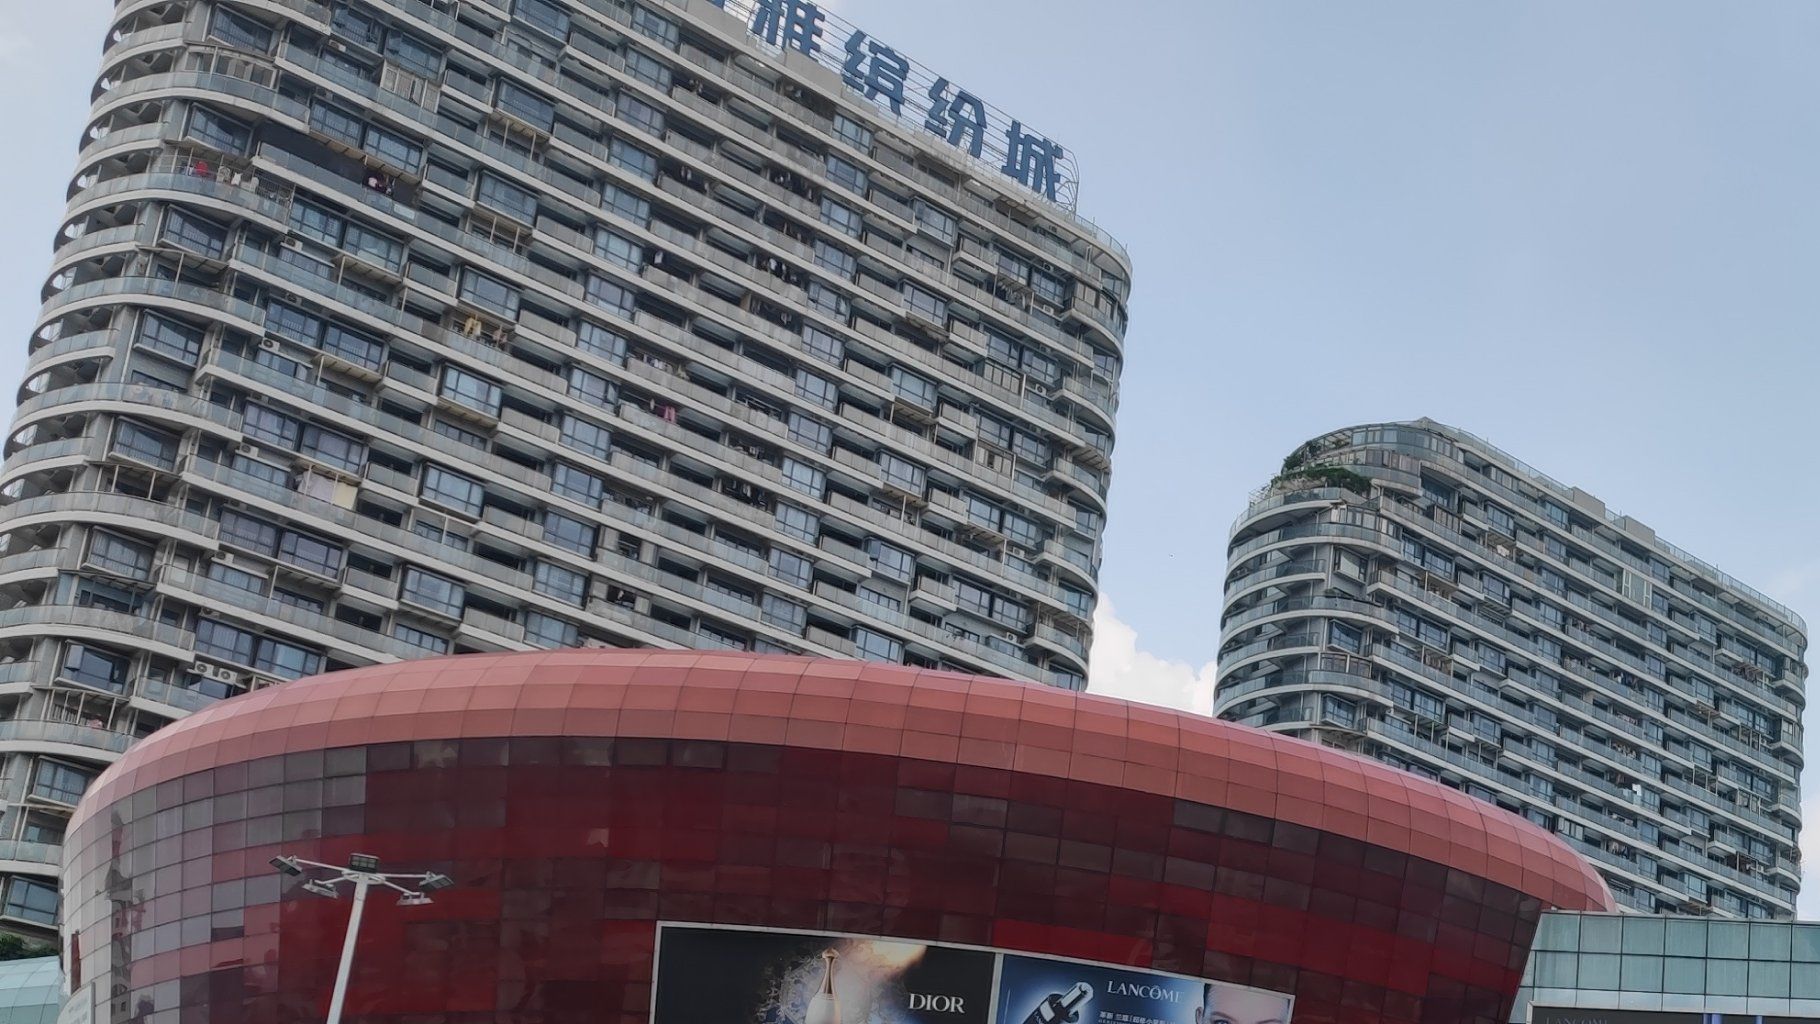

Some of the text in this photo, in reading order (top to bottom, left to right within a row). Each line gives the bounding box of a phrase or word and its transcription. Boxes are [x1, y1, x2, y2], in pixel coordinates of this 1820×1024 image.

[711, 0, 1064, 202] 雅缤纷城
[908, 993, 965, 1013] DIOR
